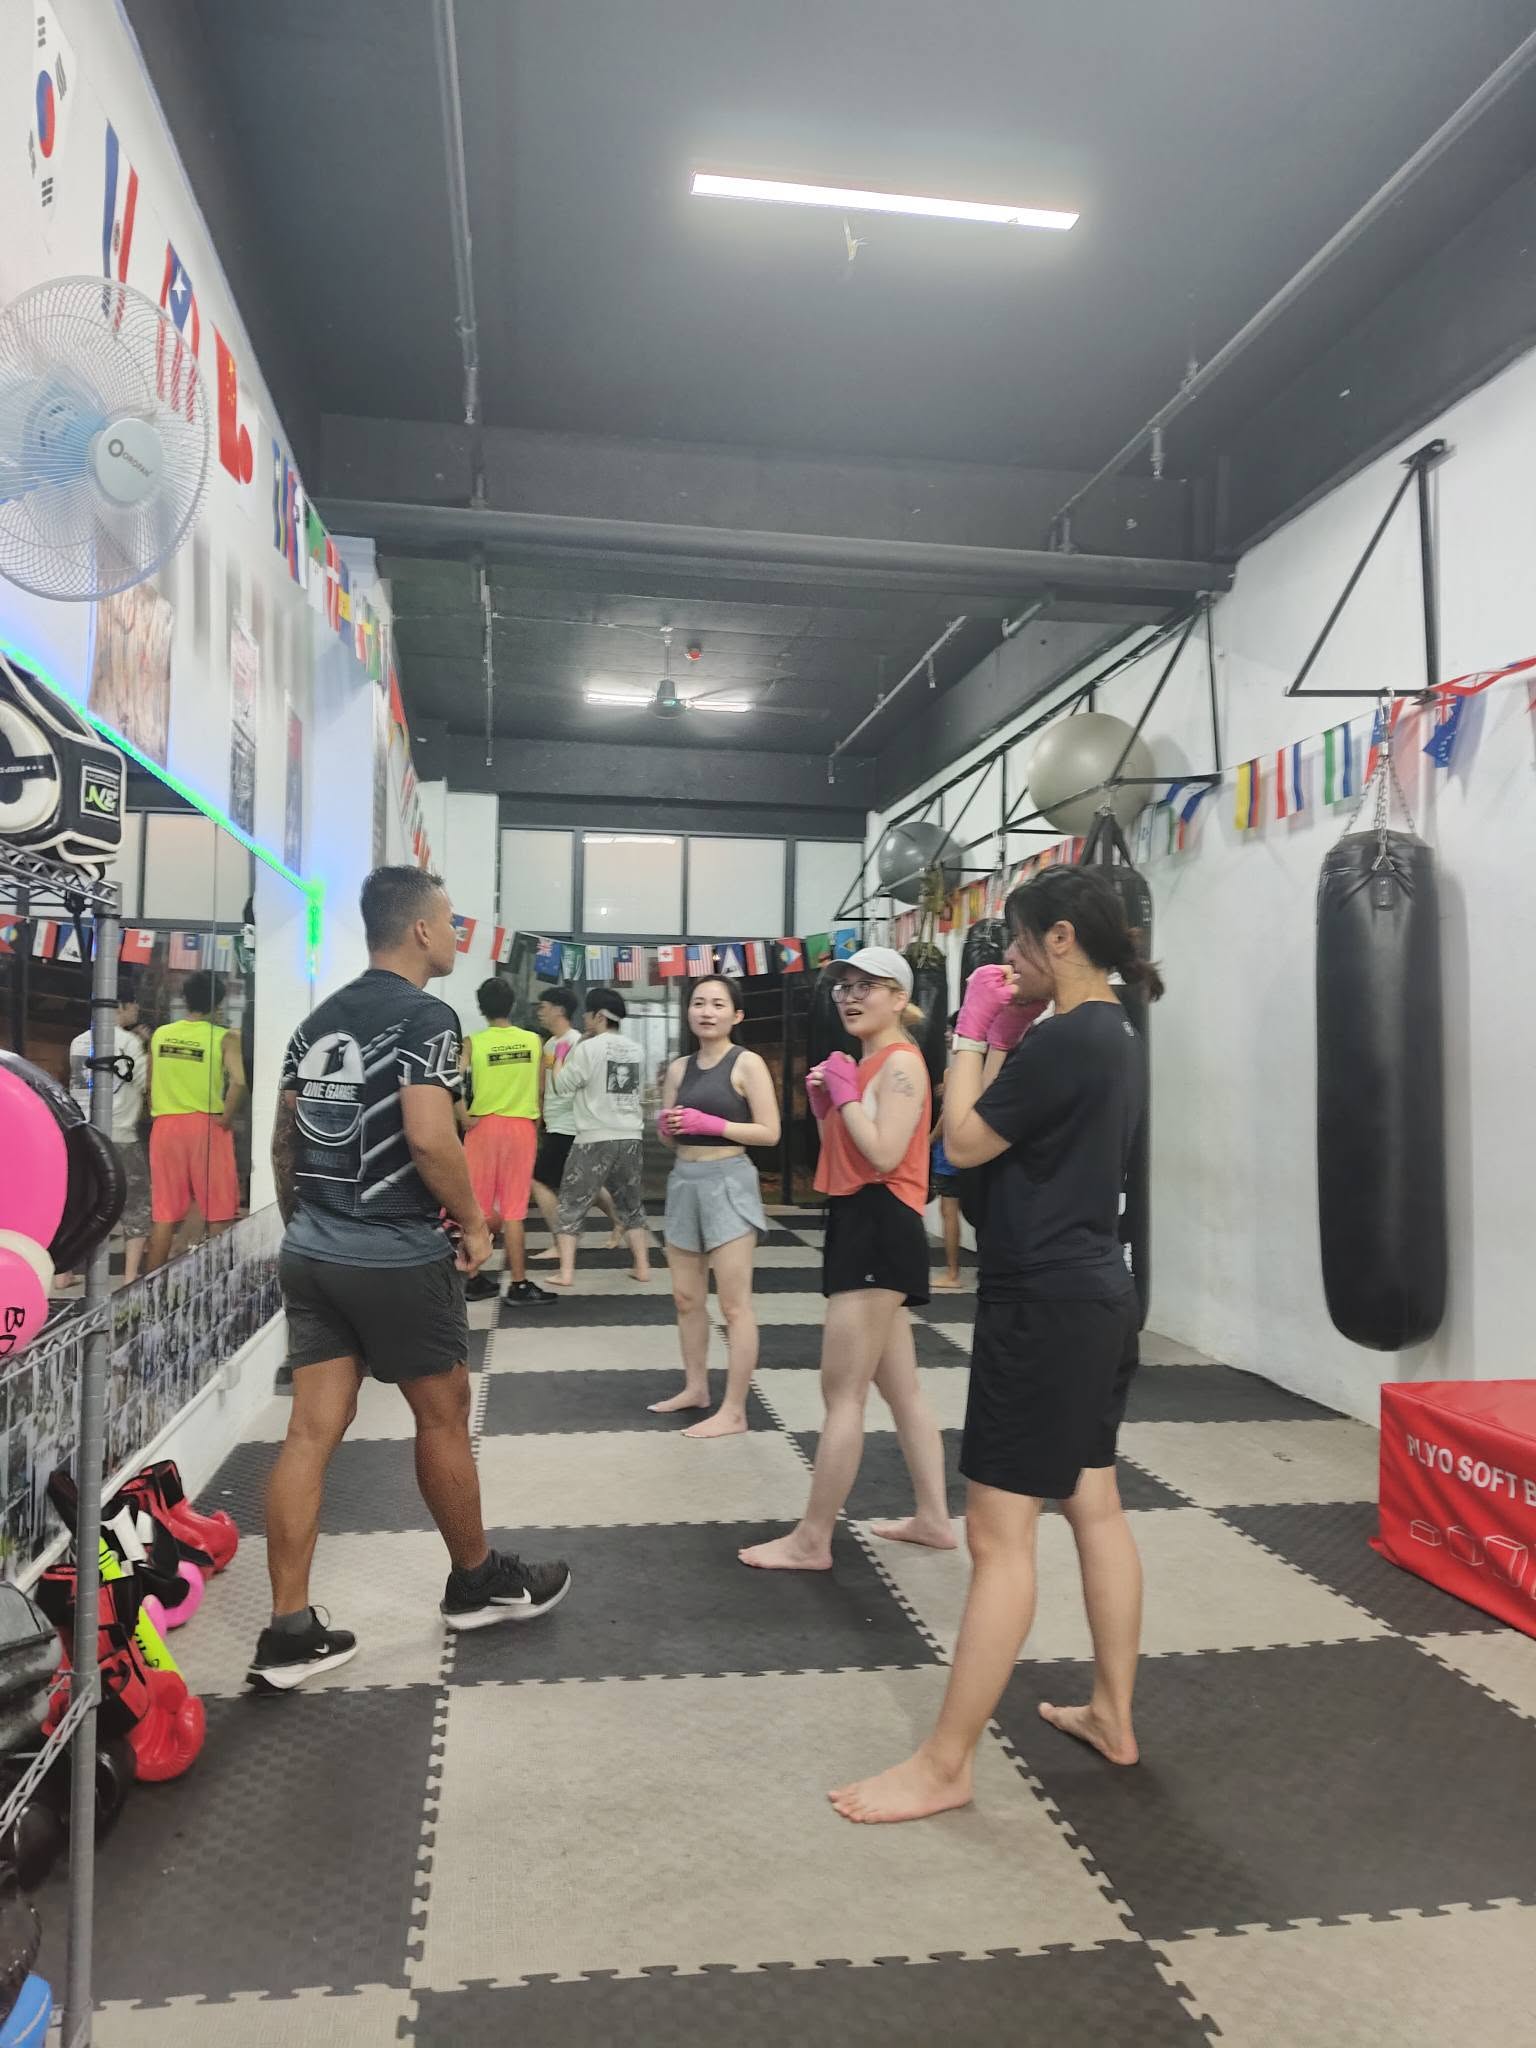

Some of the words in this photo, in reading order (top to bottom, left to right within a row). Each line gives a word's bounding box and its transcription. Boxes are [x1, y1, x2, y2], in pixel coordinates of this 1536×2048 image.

[302, 1080, 327, 1099] ONE
[1406, 1433, 1453, 1474] PLYO
[1457, 1455, 1518, 1499] SOFT
